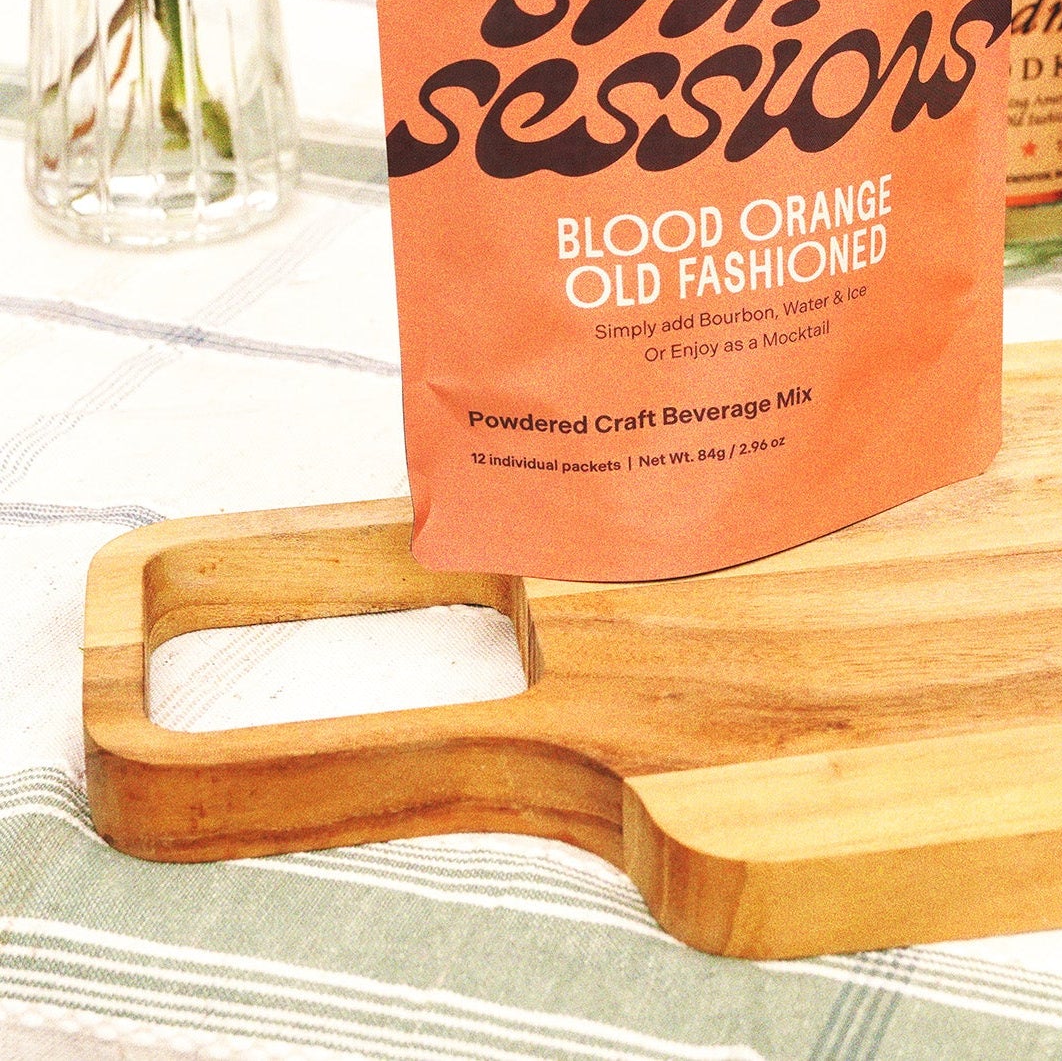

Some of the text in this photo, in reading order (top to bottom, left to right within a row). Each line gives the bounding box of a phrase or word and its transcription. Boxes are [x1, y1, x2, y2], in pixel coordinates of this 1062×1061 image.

[557, 173, 892, 259] BLOOD ORANGE
[566, 224, 887, 309] OLD FASHIONED
[595, 285, 867, 340] Simply add Bourbon, Water & Ice
[644, 320, 830, 362] Or Enjoy as a Mocktail
[468, 386, 813, 434] Powdered Craft Beverage Mix
[471, 452, 486, 465] 12
[489, 453, 558, 471] individual
[562, 459, 621, 474] packets
[639, 455, 664, 468] Net
[669, 451, 694, 465] Wt.
[698, 447, 726, 462] 84g
[729, 444, 737, 459] /
[738, 439, 768, 457] 2.96
[771, 437, 786, 448] oz
